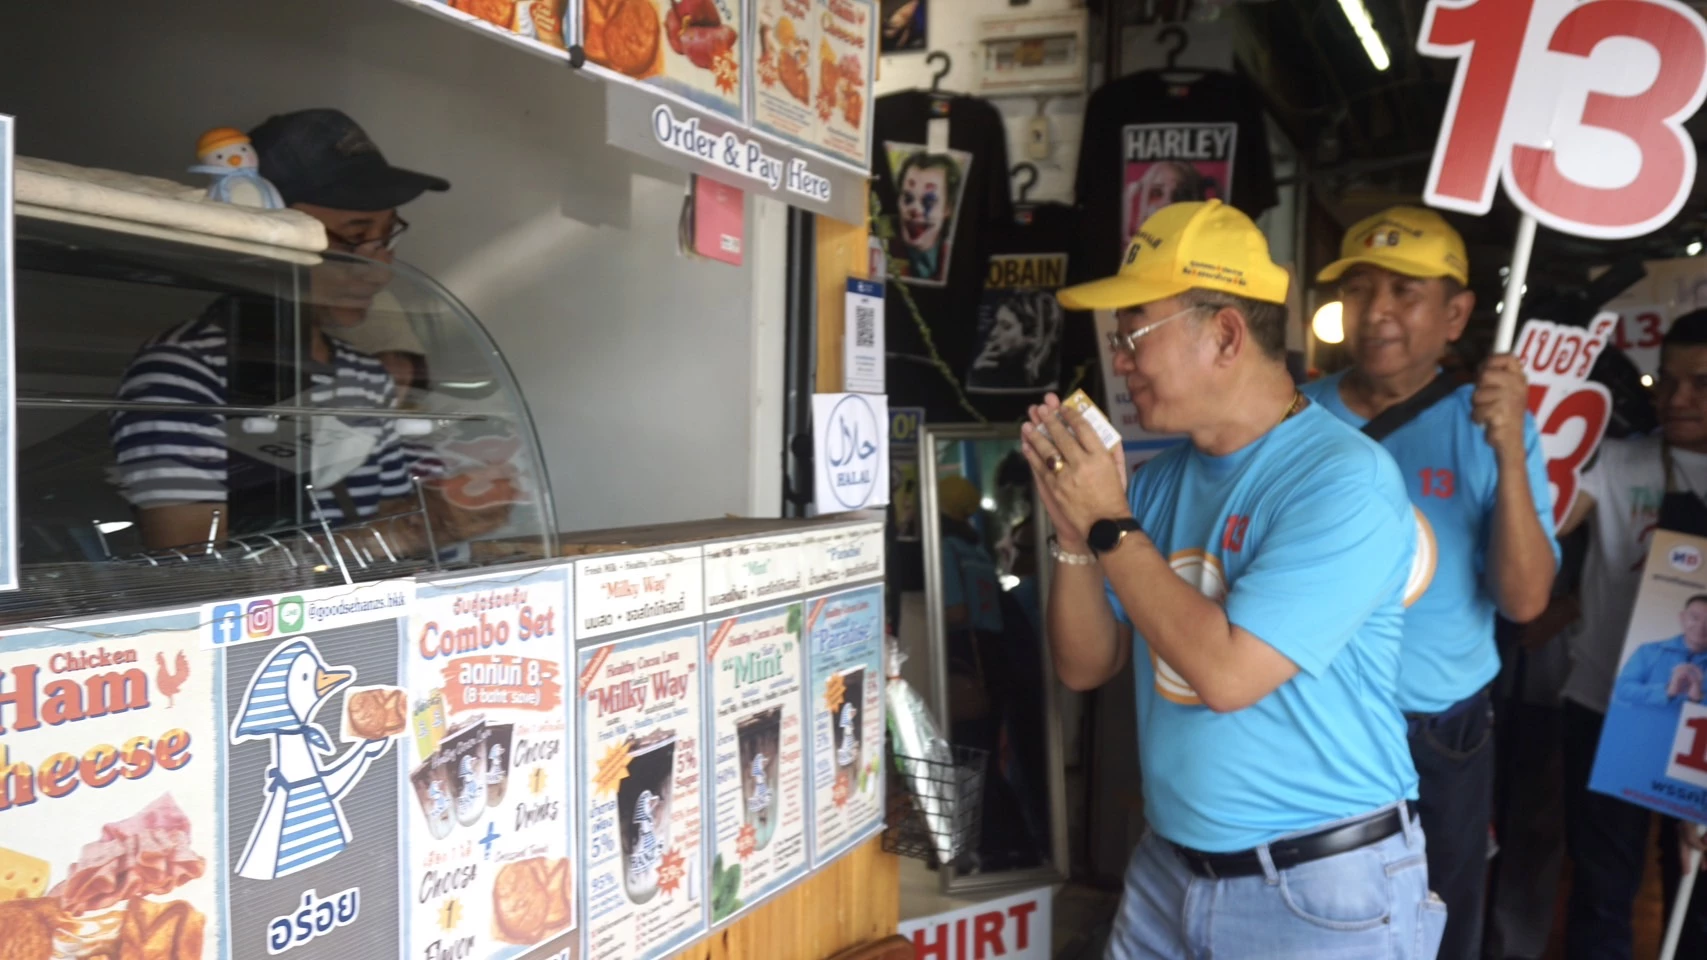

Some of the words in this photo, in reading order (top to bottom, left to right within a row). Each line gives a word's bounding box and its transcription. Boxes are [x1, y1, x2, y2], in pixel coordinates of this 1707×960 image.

[1427, 0, 1706, 231] 13
[654, 107, 717, 160] Order
[723, 135, 741, 169] &
[746, 144, 783, 187] Pay
[788, 158, 831, 200] Here
[1126, 128, 1232, 160] HARLEY
[1519, 319, 1613, 379] เบอร์
[1614, 312, 1663, 351] 13
[829, 414, 877, 468] حلال
[836, 469, 871, 487] HALAL
[1418, 466, 1456, 500] 13
[1221, 513, 1250, 553] 13
[600, 579, 640, 600] “Milky
[418, 612, 511, 661] Combo
[518, 605, 556, 641] Set
[584, 614, 613, 630] นมสด
[49, 646, 138, 675] Chicken
[459, 655, 525, 687] ลดทันที
[606, 661, 636, 679] Healthy
[637, 655, 661, 670] Cocoa
[662, 650, 680, 664] Lava
[722, 641, 794, 689] “Mint”
[0, 664, 150, 736] Ham
[463, 686, 479, 706] (8
[480, 687, 508, 705] baht
[510, 687, 542, 707] save)
[587, 679, 648, 718] “Milky
[650, 663, 698, 700] Way”
[0, 727, 192, 812] heese
[513, 738, 561, 768] Choose
[677, 750, 698, 774] 5%
[533, 767, 542, 794] 1
[674, 772, 700, 790] Sugar
[513, 795, 561, 833] Drinks
[591, 833, 616, 859] 5%
[418, 862, 479, 905] Choose
[271, 889, 358, 951] อร่อย
[913, 900, 1037, 960] HIRT
